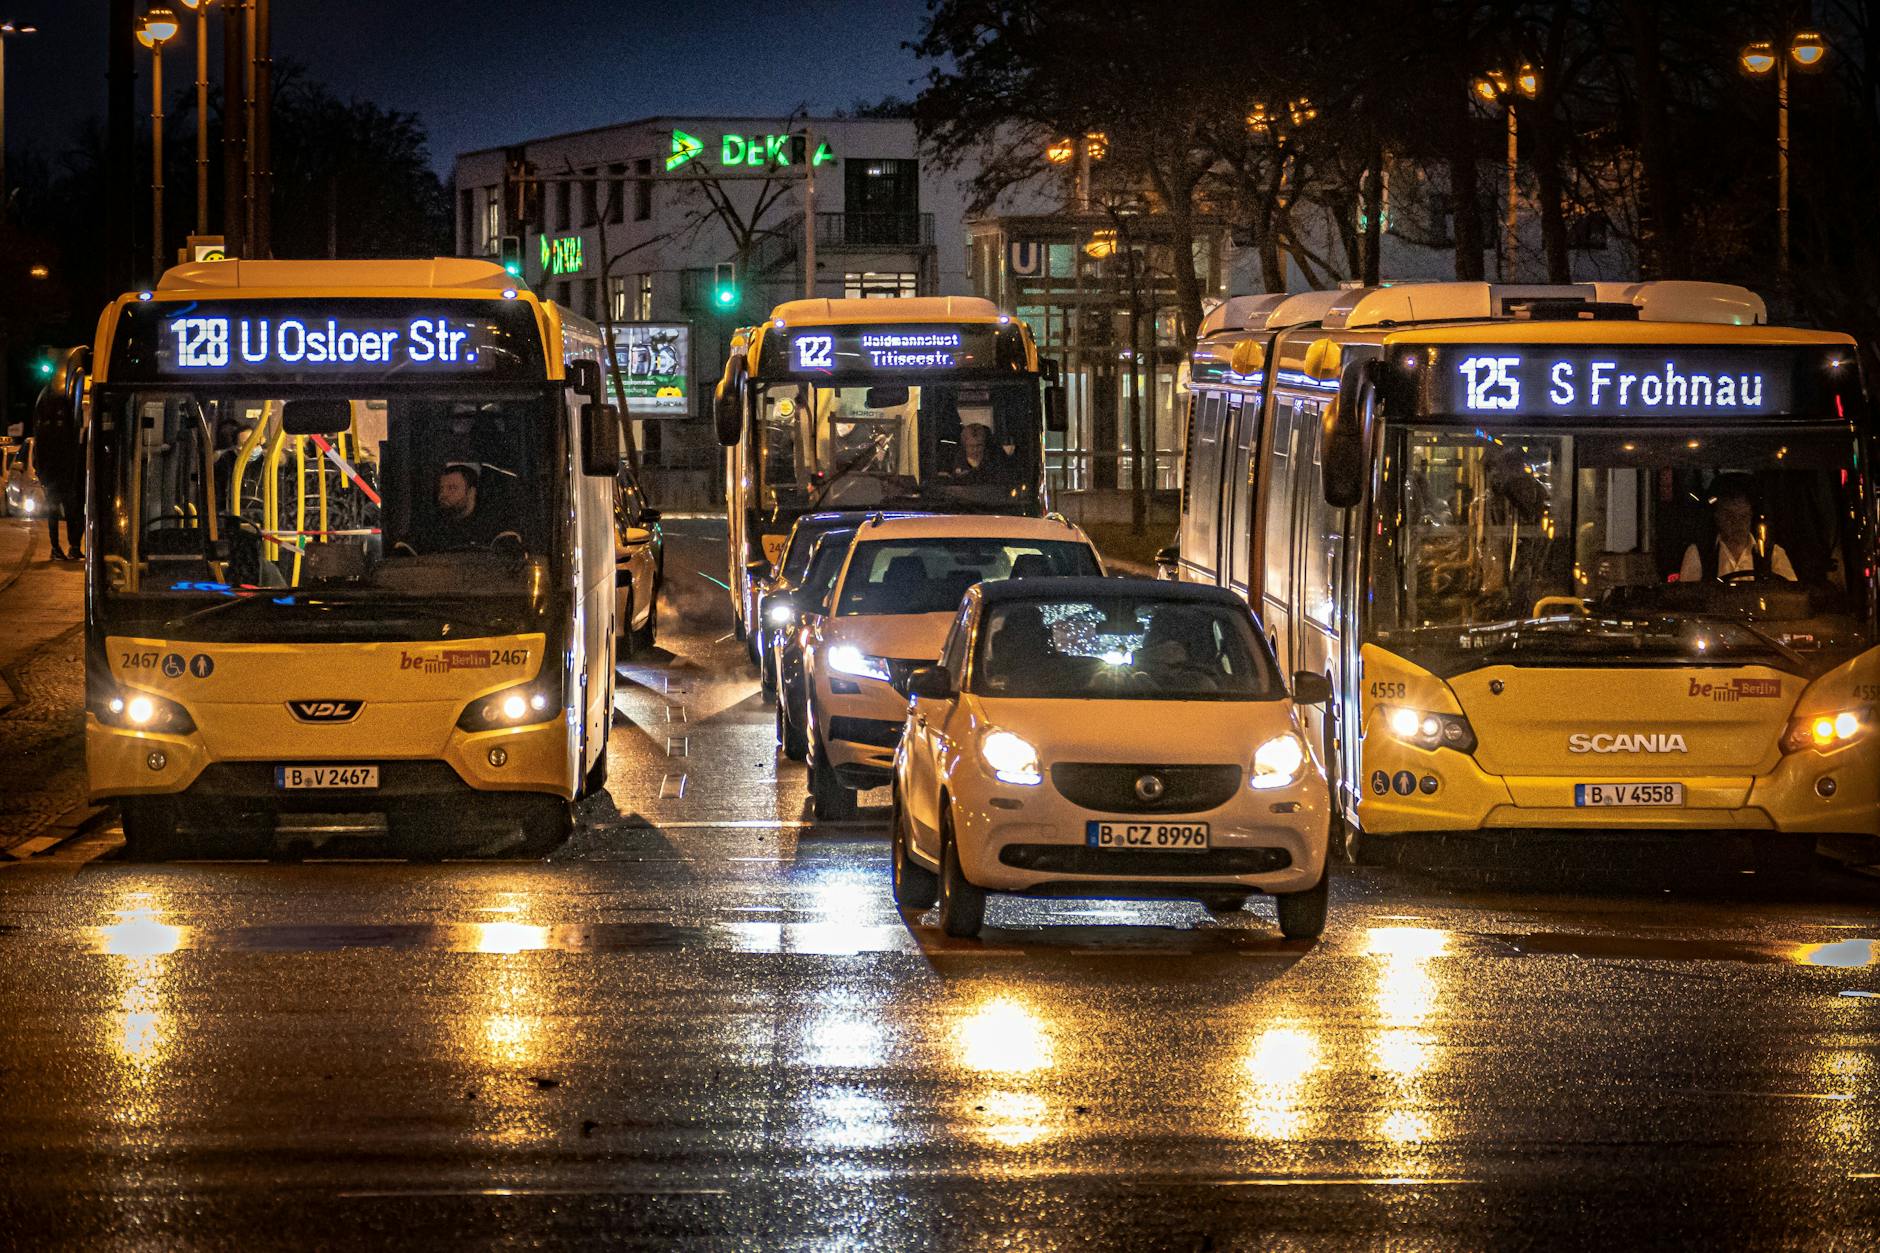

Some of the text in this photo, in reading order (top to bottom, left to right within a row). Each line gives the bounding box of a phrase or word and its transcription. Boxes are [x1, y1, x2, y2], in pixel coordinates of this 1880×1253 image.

[722, 134, 837, 167] DEKA
[1012, 242, 1037, 274] U
[171, 319, 476, 367] 128 U Osloer Str.
[795, 334, 959, 367] 122 Waldmannslust
[870, 351, 954, 366] Titiseestr.
[1459, 357, 1762, 409] 125 S Frohnau
[122, 653, 159, 669] 2467
[400, 651, 486, 670] be Berlin
[491, 650, 528, 665] 2467
[1370, 682, 1406, 699] 4558
[1688, 677, 1777, 697] be Berlin
[300, 703, 351, 716] VDL
[1568, 734, 1688, 753] SCANIA
[292, 769, 370, 786] B V 2467
[1591, 785, 1674, 803] B V 4558
[1100, 825, 1113, 845] B
[1127, 826, 1152, 845] CZ
[1157, 826, 1205, 846] 8996
